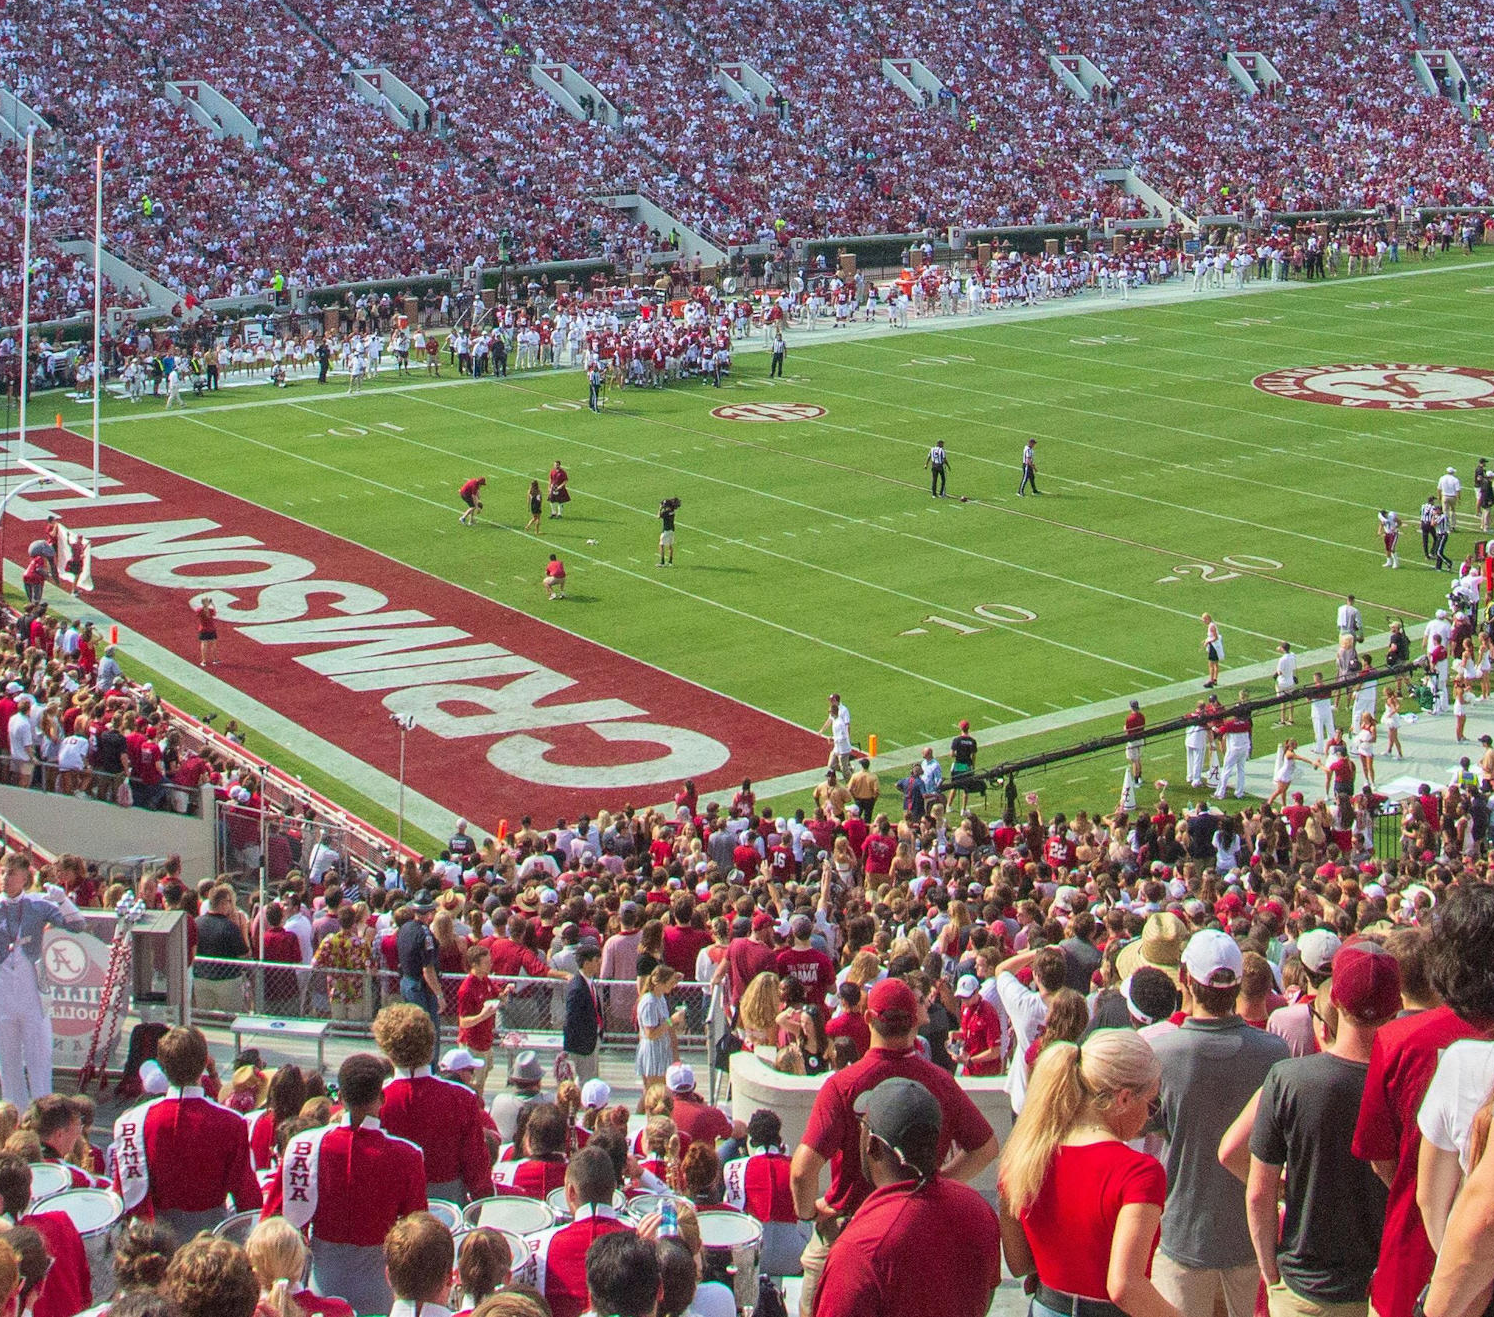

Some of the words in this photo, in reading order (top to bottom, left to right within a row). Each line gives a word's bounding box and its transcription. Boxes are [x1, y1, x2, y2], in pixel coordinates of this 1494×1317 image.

[1170, 554, 1285, 583] 20
[921, 602, 1039, 636] 10
[62, 518, 730, 789] CRIMSON
[1210, 765, 1220, 780] A
[770, 850, 782, 865] 16
[1049, 841, 1068, 861] 22
[120, 1122, 143, 1179] BAMA
[289, 1141, 313, 1203] BAMA
[729, 1162, 741, 1200] BAMA
